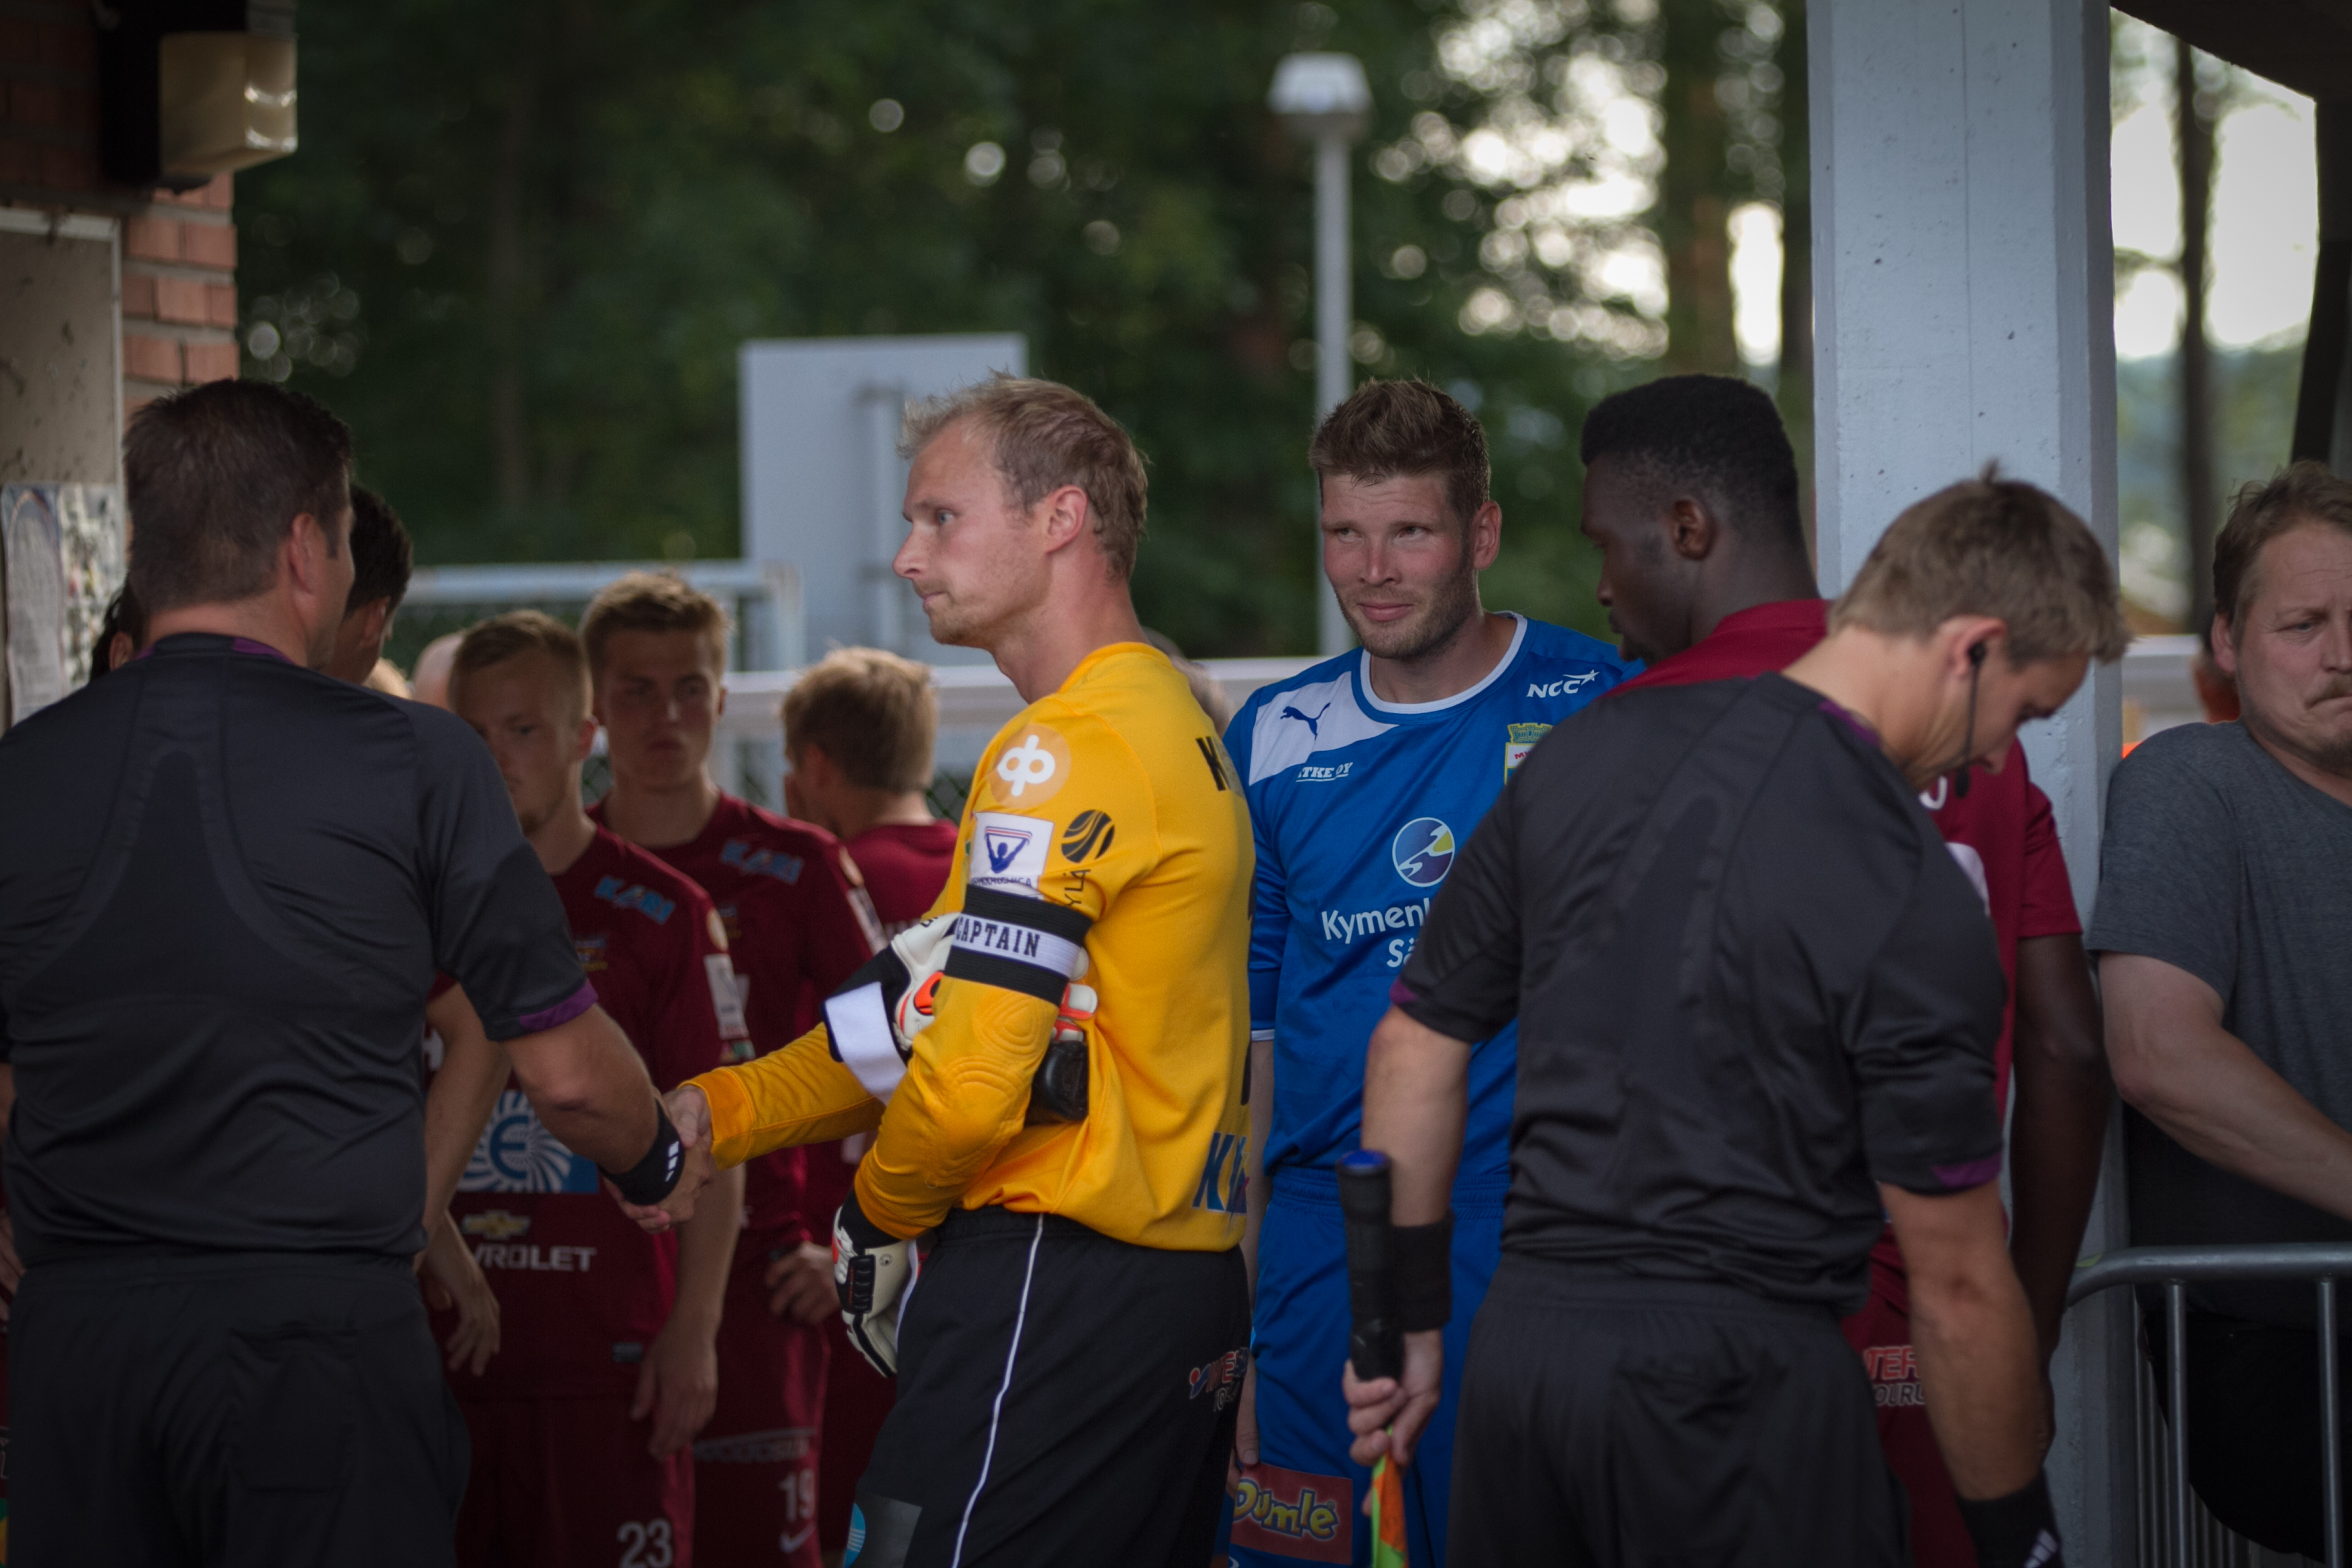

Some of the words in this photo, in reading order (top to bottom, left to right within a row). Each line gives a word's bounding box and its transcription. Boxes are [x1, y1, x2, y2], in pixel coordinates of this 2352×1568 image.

[1526, 680, 1581, 698] NCC
[1336, 762, 1353, 775] OY
[956, 916, 1040, 958] CAPTAIN
[1232, 1476, 1339, 1540] Dumle
[616, 1518, 673, 1568] 23
